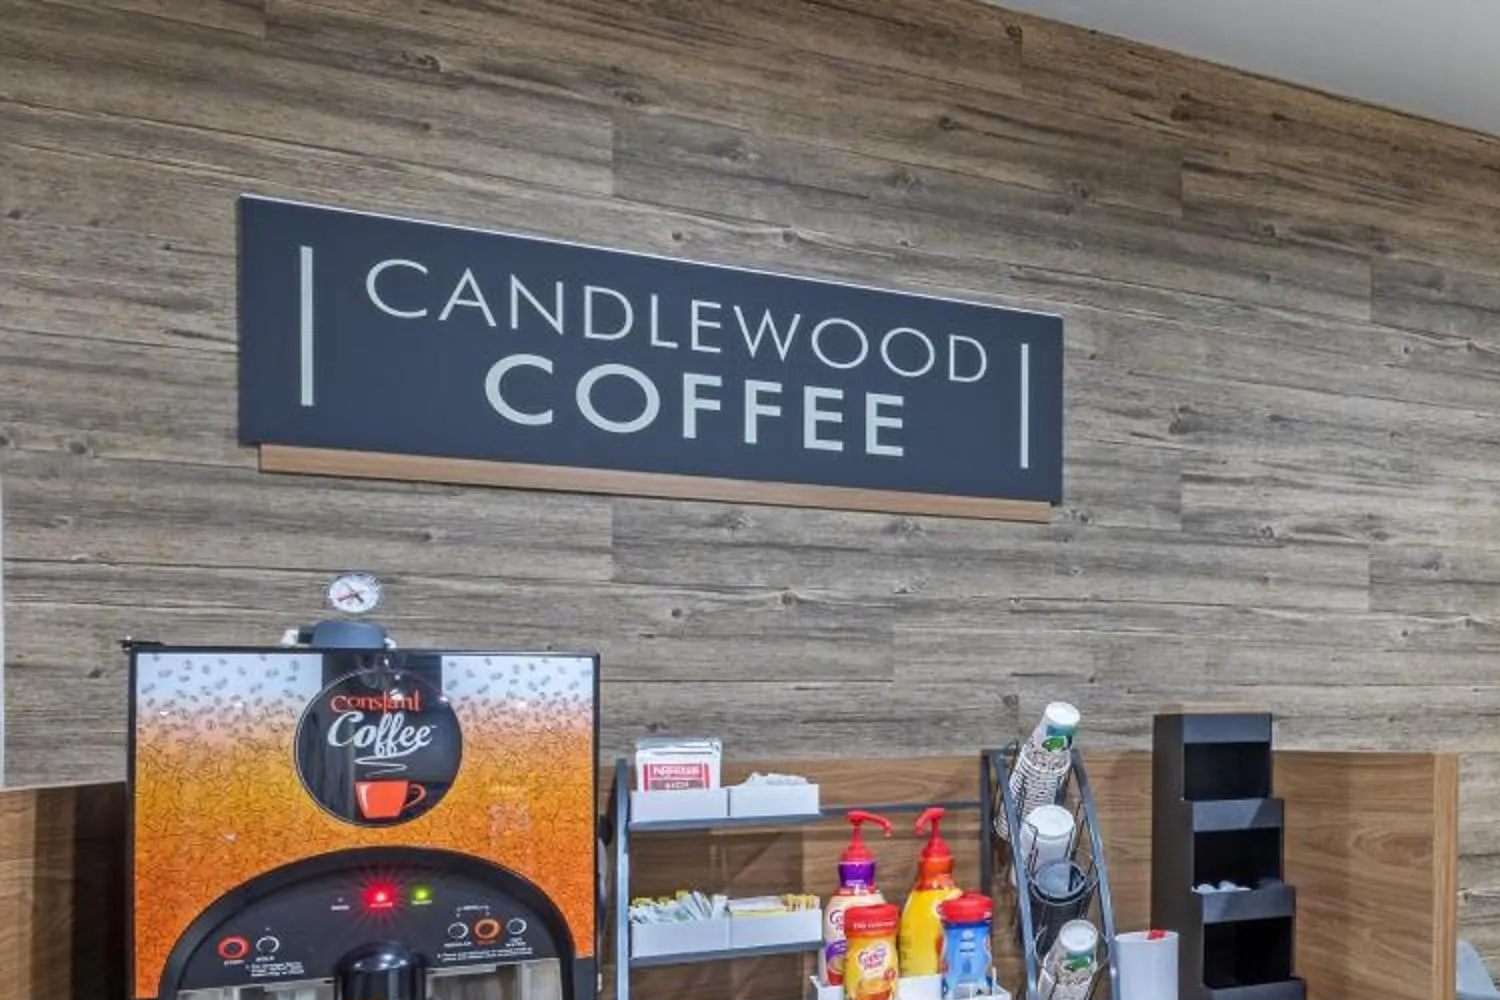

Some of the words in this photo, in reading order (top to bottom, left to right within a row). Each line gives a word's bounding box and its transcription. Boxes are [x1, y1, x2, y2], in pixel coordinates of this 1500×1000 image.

[365, 258, 988, 383] CANDLEWOOD
[484, 353, 906, 458] COFFEE
[327, 710, 433, 758] Coffee
